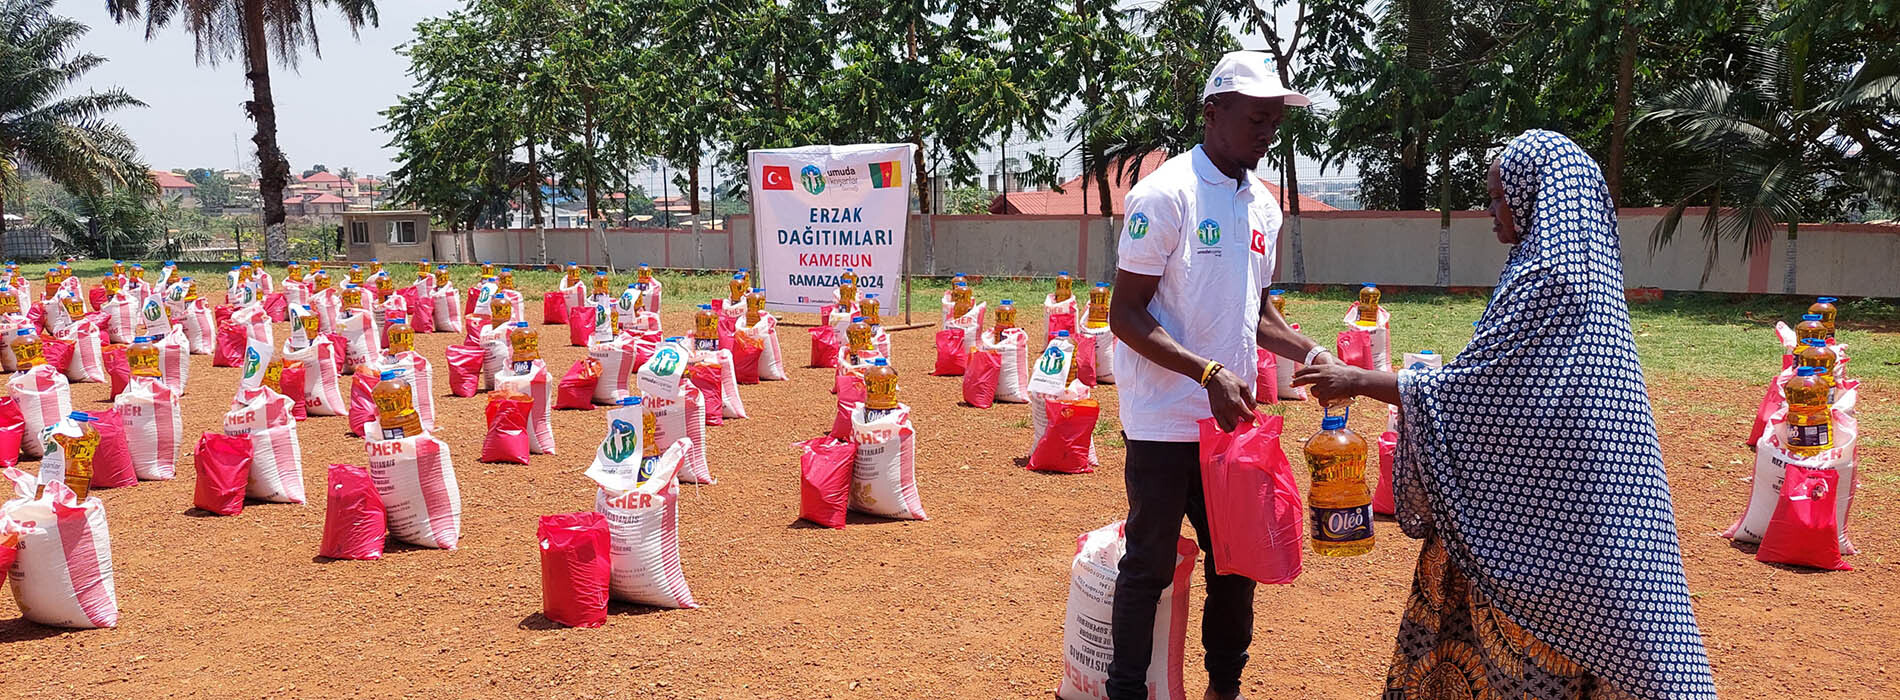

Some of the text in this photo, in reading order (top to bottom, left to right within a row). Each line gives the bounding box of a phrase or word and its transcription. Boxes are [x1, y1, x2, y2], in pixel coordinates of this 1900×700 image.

[827, 166, 856, 176] umuda
[809, 207, 863, 223] ERZAK
[777, 226, 893, 246] DAĞITIMLARI
[799, 253, 872, 267] KAMERUN
[789, 274, 884, 288] RAMAZA 2024
[1328, 511, 1364, 533] Oléo
